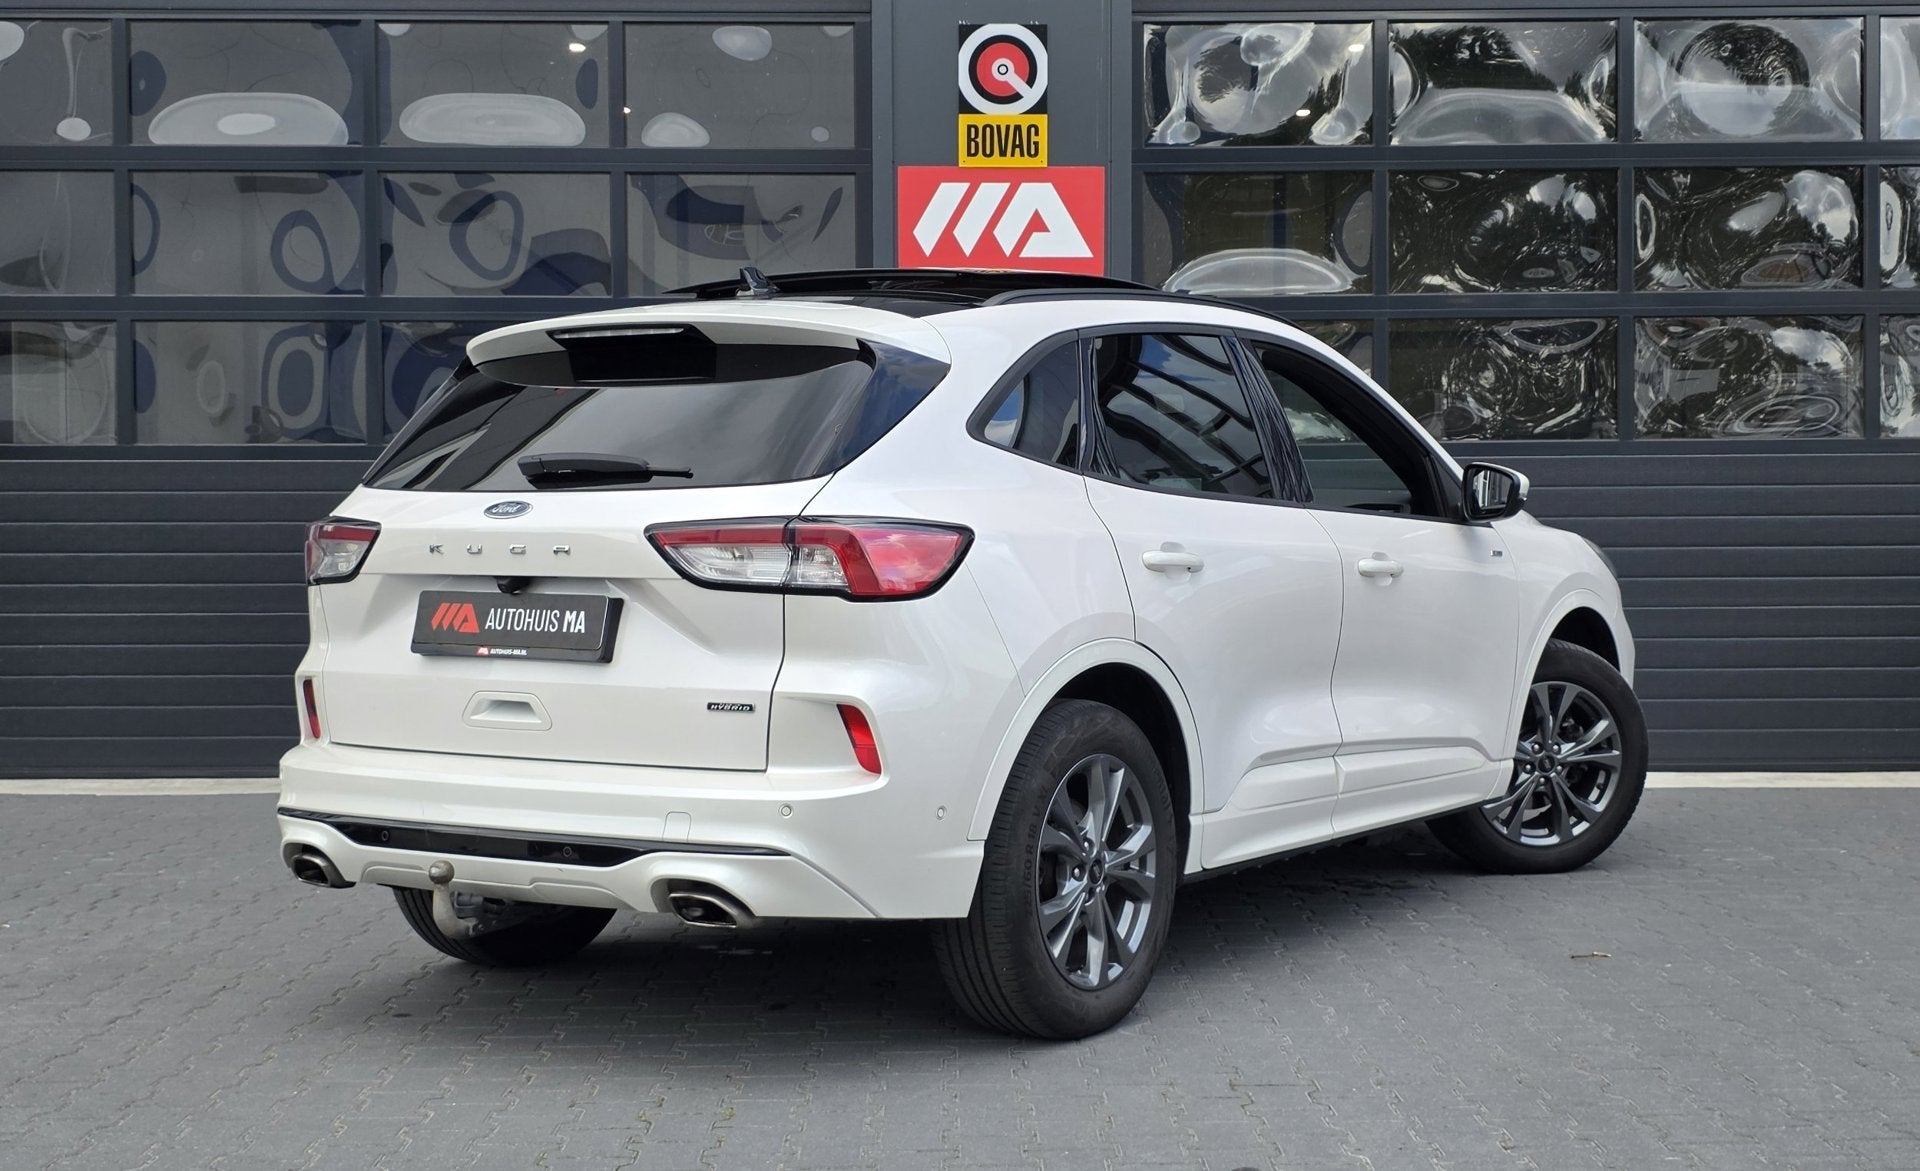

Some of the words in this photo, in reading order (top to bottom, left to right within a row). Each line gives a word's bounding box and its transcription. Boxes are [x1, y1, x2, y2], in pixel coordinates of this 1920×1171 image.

[966, 123, 1040, 158] BOVAG
[491, 503, 521, 513] Ford
[428, 543, 571, 556] KUGA
[485, 607, 560, 632] AUTOHUIS
[562, 610, 586, 633] MA
